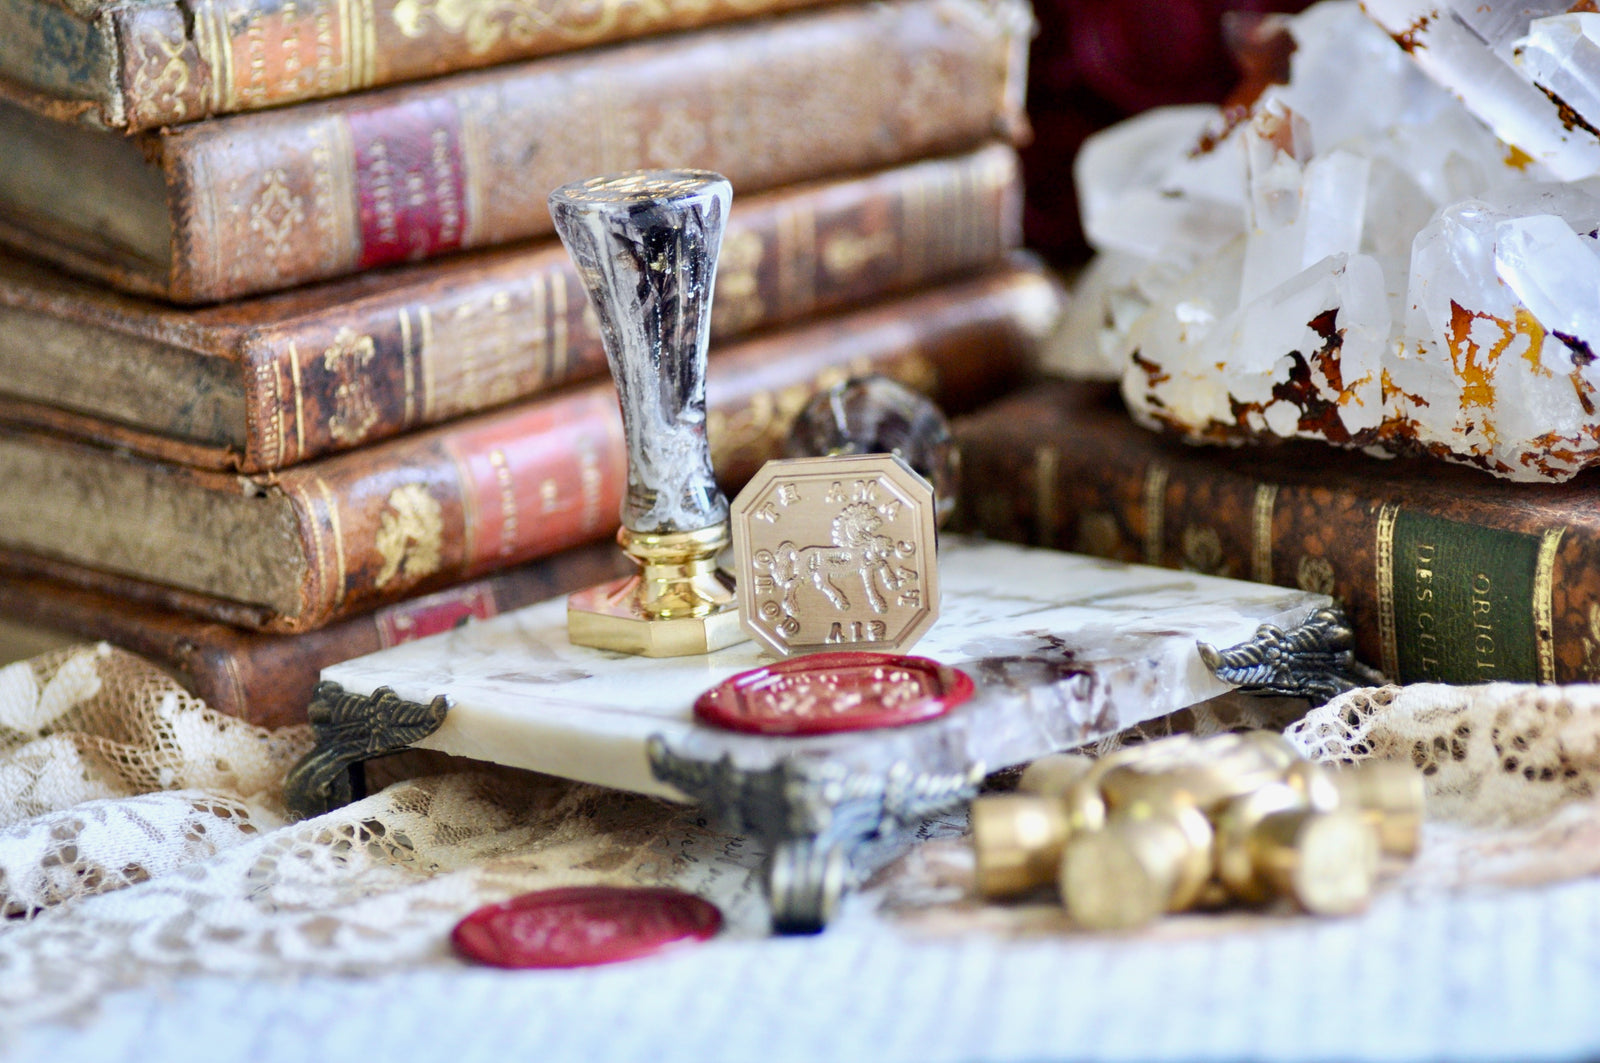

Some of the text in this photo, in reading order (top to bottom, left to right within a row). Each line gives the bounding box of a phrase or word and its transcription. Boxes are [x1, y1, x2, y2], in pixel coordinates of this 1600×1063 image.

[1416, 544, 1442, 682] DES CUL
[1472, 573, 1497, 682] ORIGI
